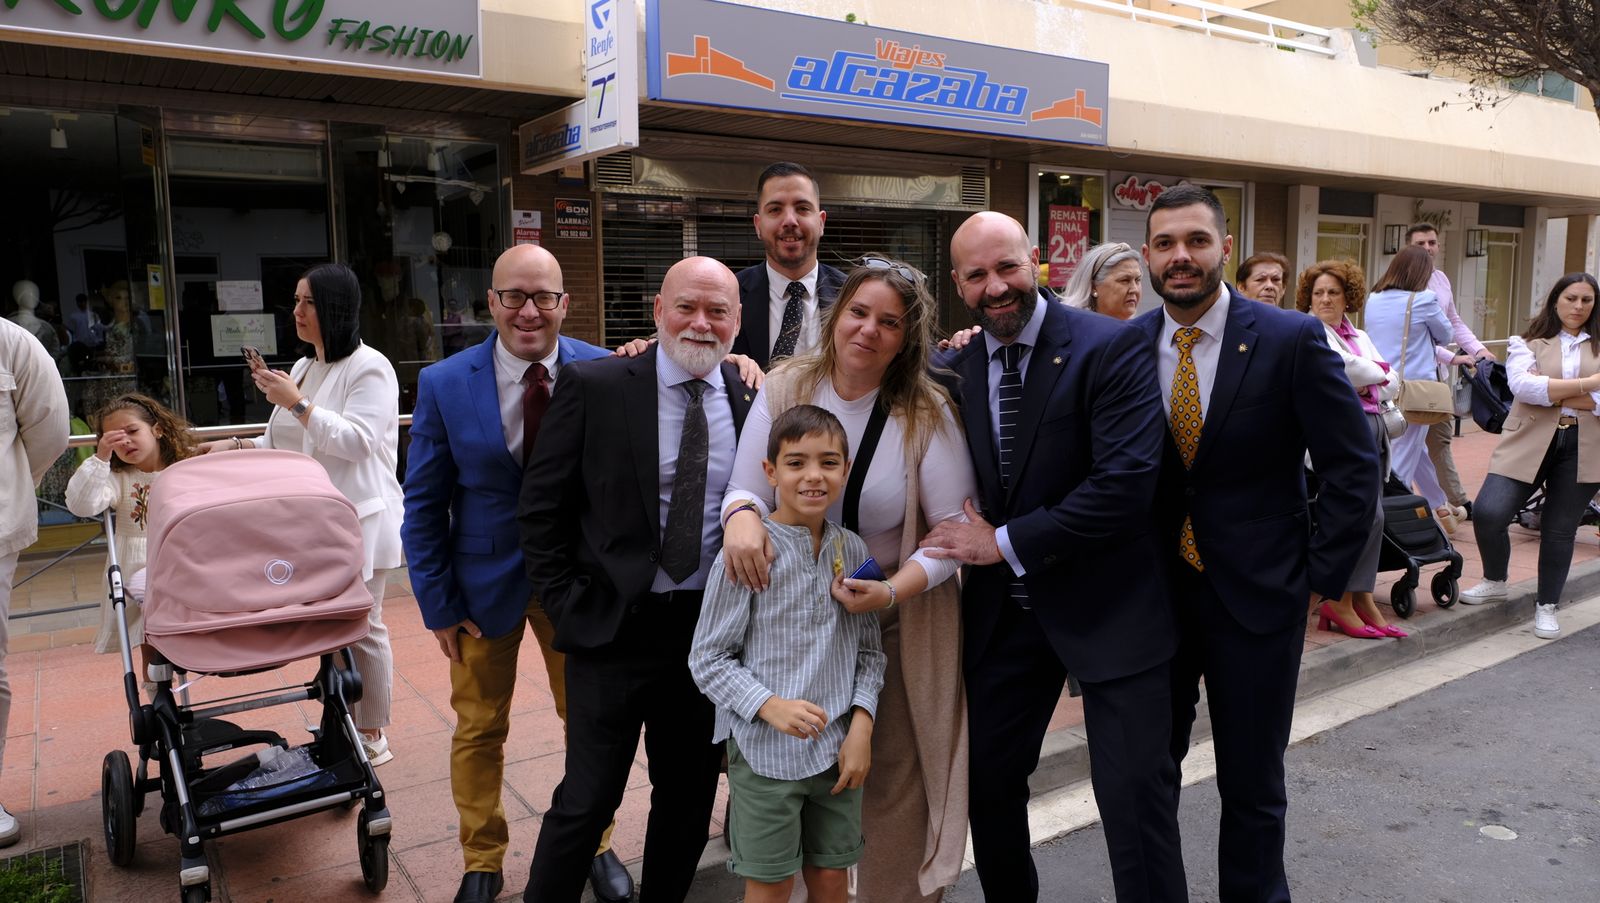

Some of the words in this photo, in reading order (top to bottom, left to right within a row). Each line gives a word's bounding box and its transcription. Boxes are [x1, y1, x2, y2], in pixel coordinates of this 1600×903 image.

[328, 18, 473, 62] FASHION
[590, 30, 614, 57] Renfe
[875, 38, 946, 71] Viajes
[786, 50, 1030, 116] alcazaba
[565, 206, 589, 214] SDN
[1050, 209, 1088, 222] REMATE
[516, 228, 540, 237] Alarma
[1055, 221, 1083, 233] FINAL
[1050, 235, 1088, 264] 2x1
